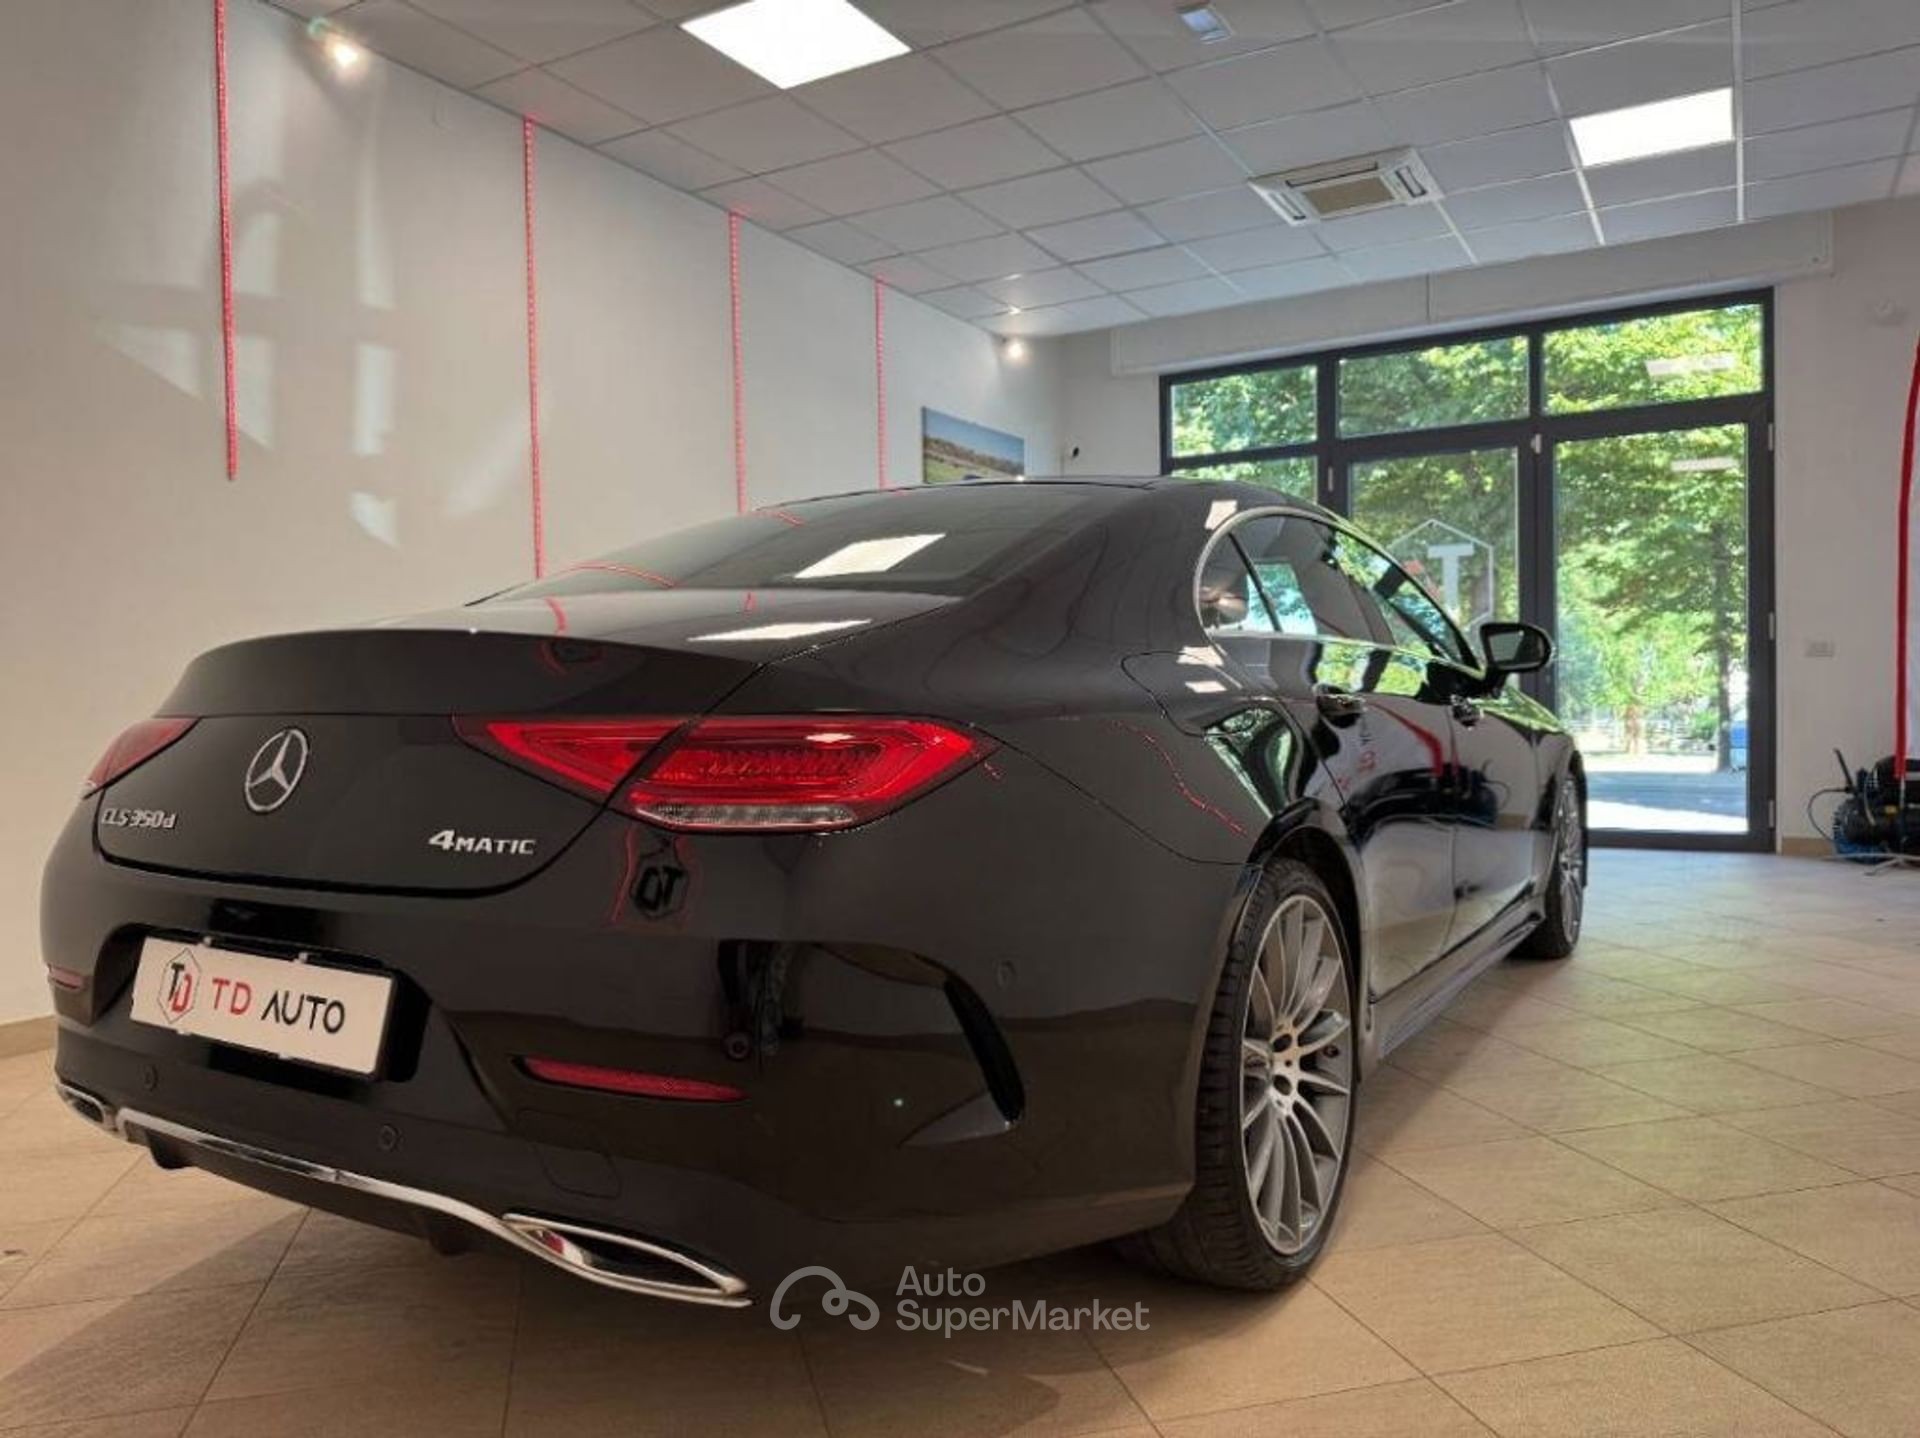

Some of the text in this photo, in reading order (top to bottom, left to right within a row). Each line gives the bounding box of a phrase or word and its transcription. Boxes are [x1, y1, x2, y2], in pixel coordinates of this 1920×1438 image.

[101, 808, 177, 829] CLS 350d
[428, 828, 537, 855] 4MATIC
[211, 977, 346, 1034] TD AUTO
